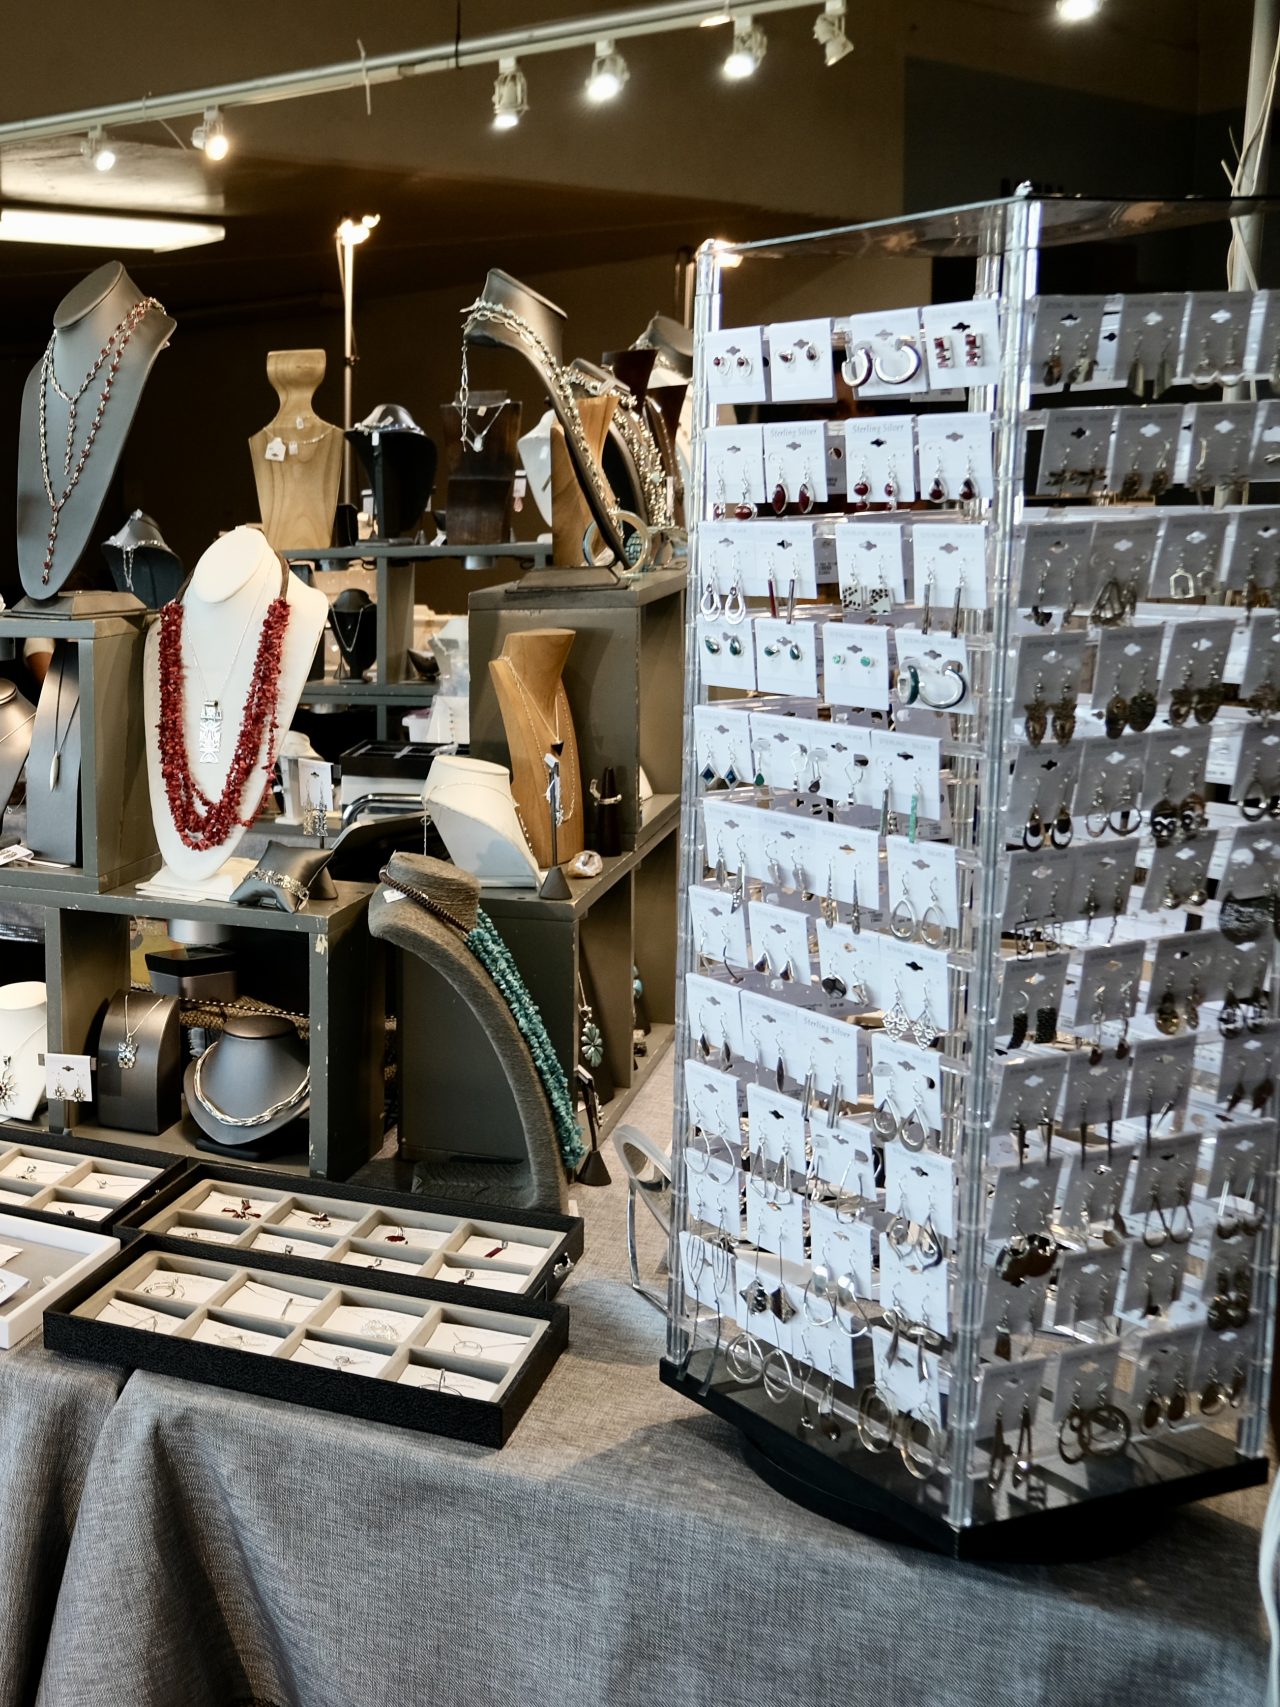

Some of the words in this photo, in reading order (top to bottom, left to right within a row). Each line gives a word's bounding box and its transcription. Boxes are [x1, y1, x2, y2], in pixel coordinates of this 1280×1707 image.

[771, 427, 796, 437] Sterling
[799, 427, 817, 436] Silver
[853, 424, 882, 434] Sterling
[883, 423, 904, 432] Silver
[804, 1017, 829, 1033] Sterling
